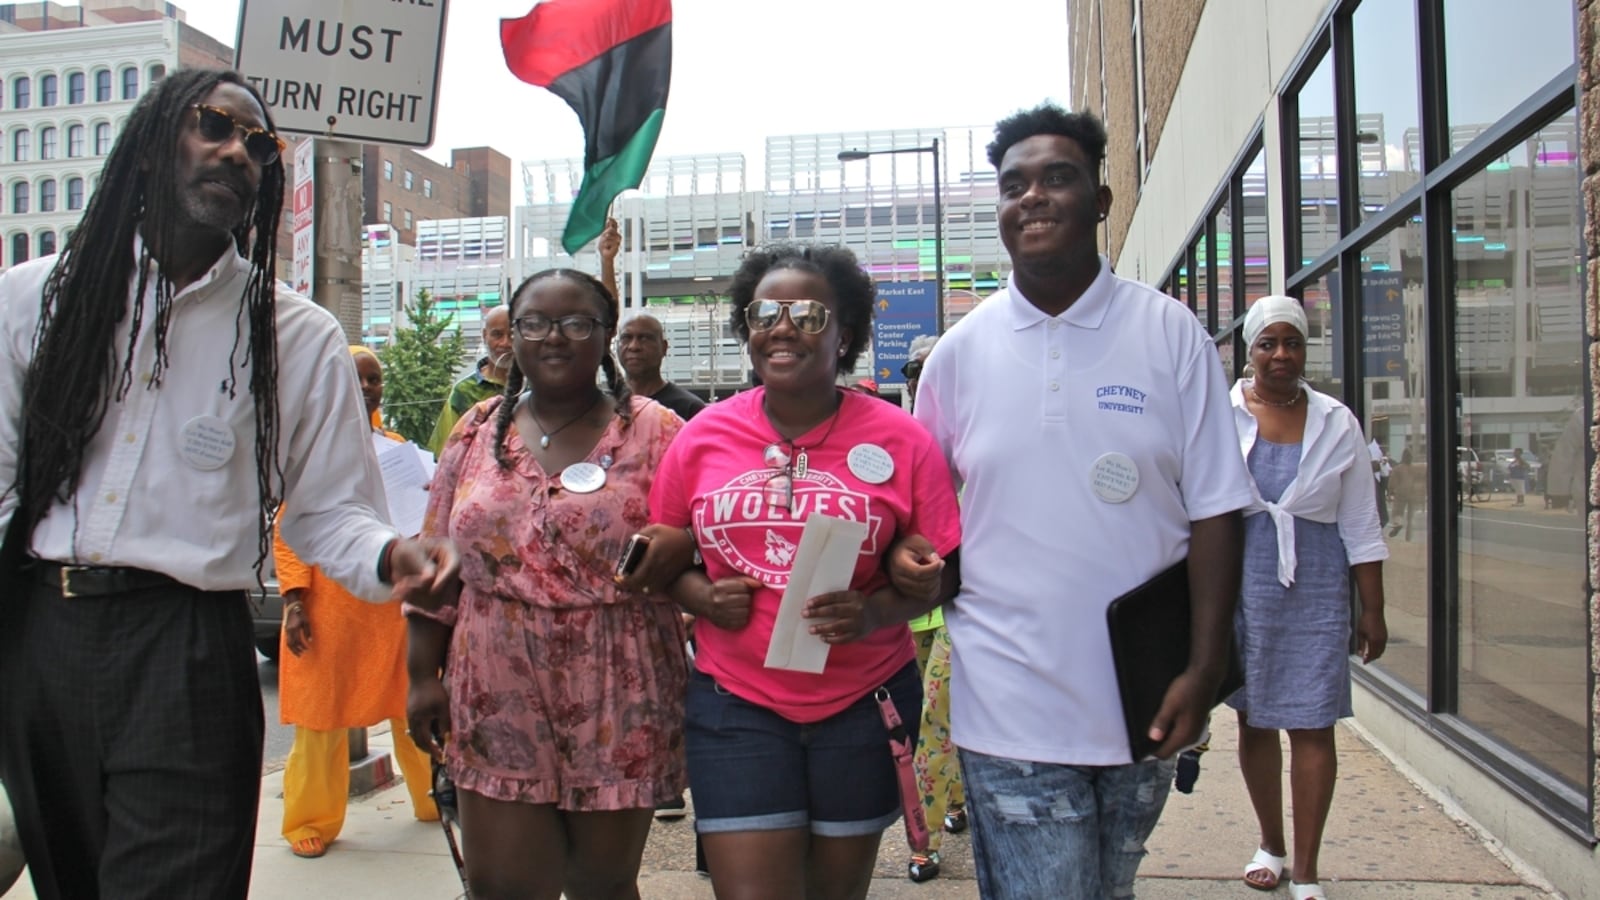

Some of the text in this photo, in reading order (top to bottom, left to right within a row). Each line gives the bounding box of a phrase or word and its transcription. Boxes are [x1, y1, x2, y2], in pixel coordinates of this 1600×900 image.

[279, 16, 402, 63] MUST
[247, 76, 422, 122] TURN RIGHT
[877, 287, 925, 296] Market East
[878, 331, 905, 339] Center
[878, 340, 908, 349] Parking
[878, 352, 911, 360] Chinato
[1096, 385, 1147, 402] CHEYNEY
[1098, 401, 1144, 415] UNIVERSITY
[712, 491, 857, 523] WOLVES
[719, 538, 733, 555] OF
